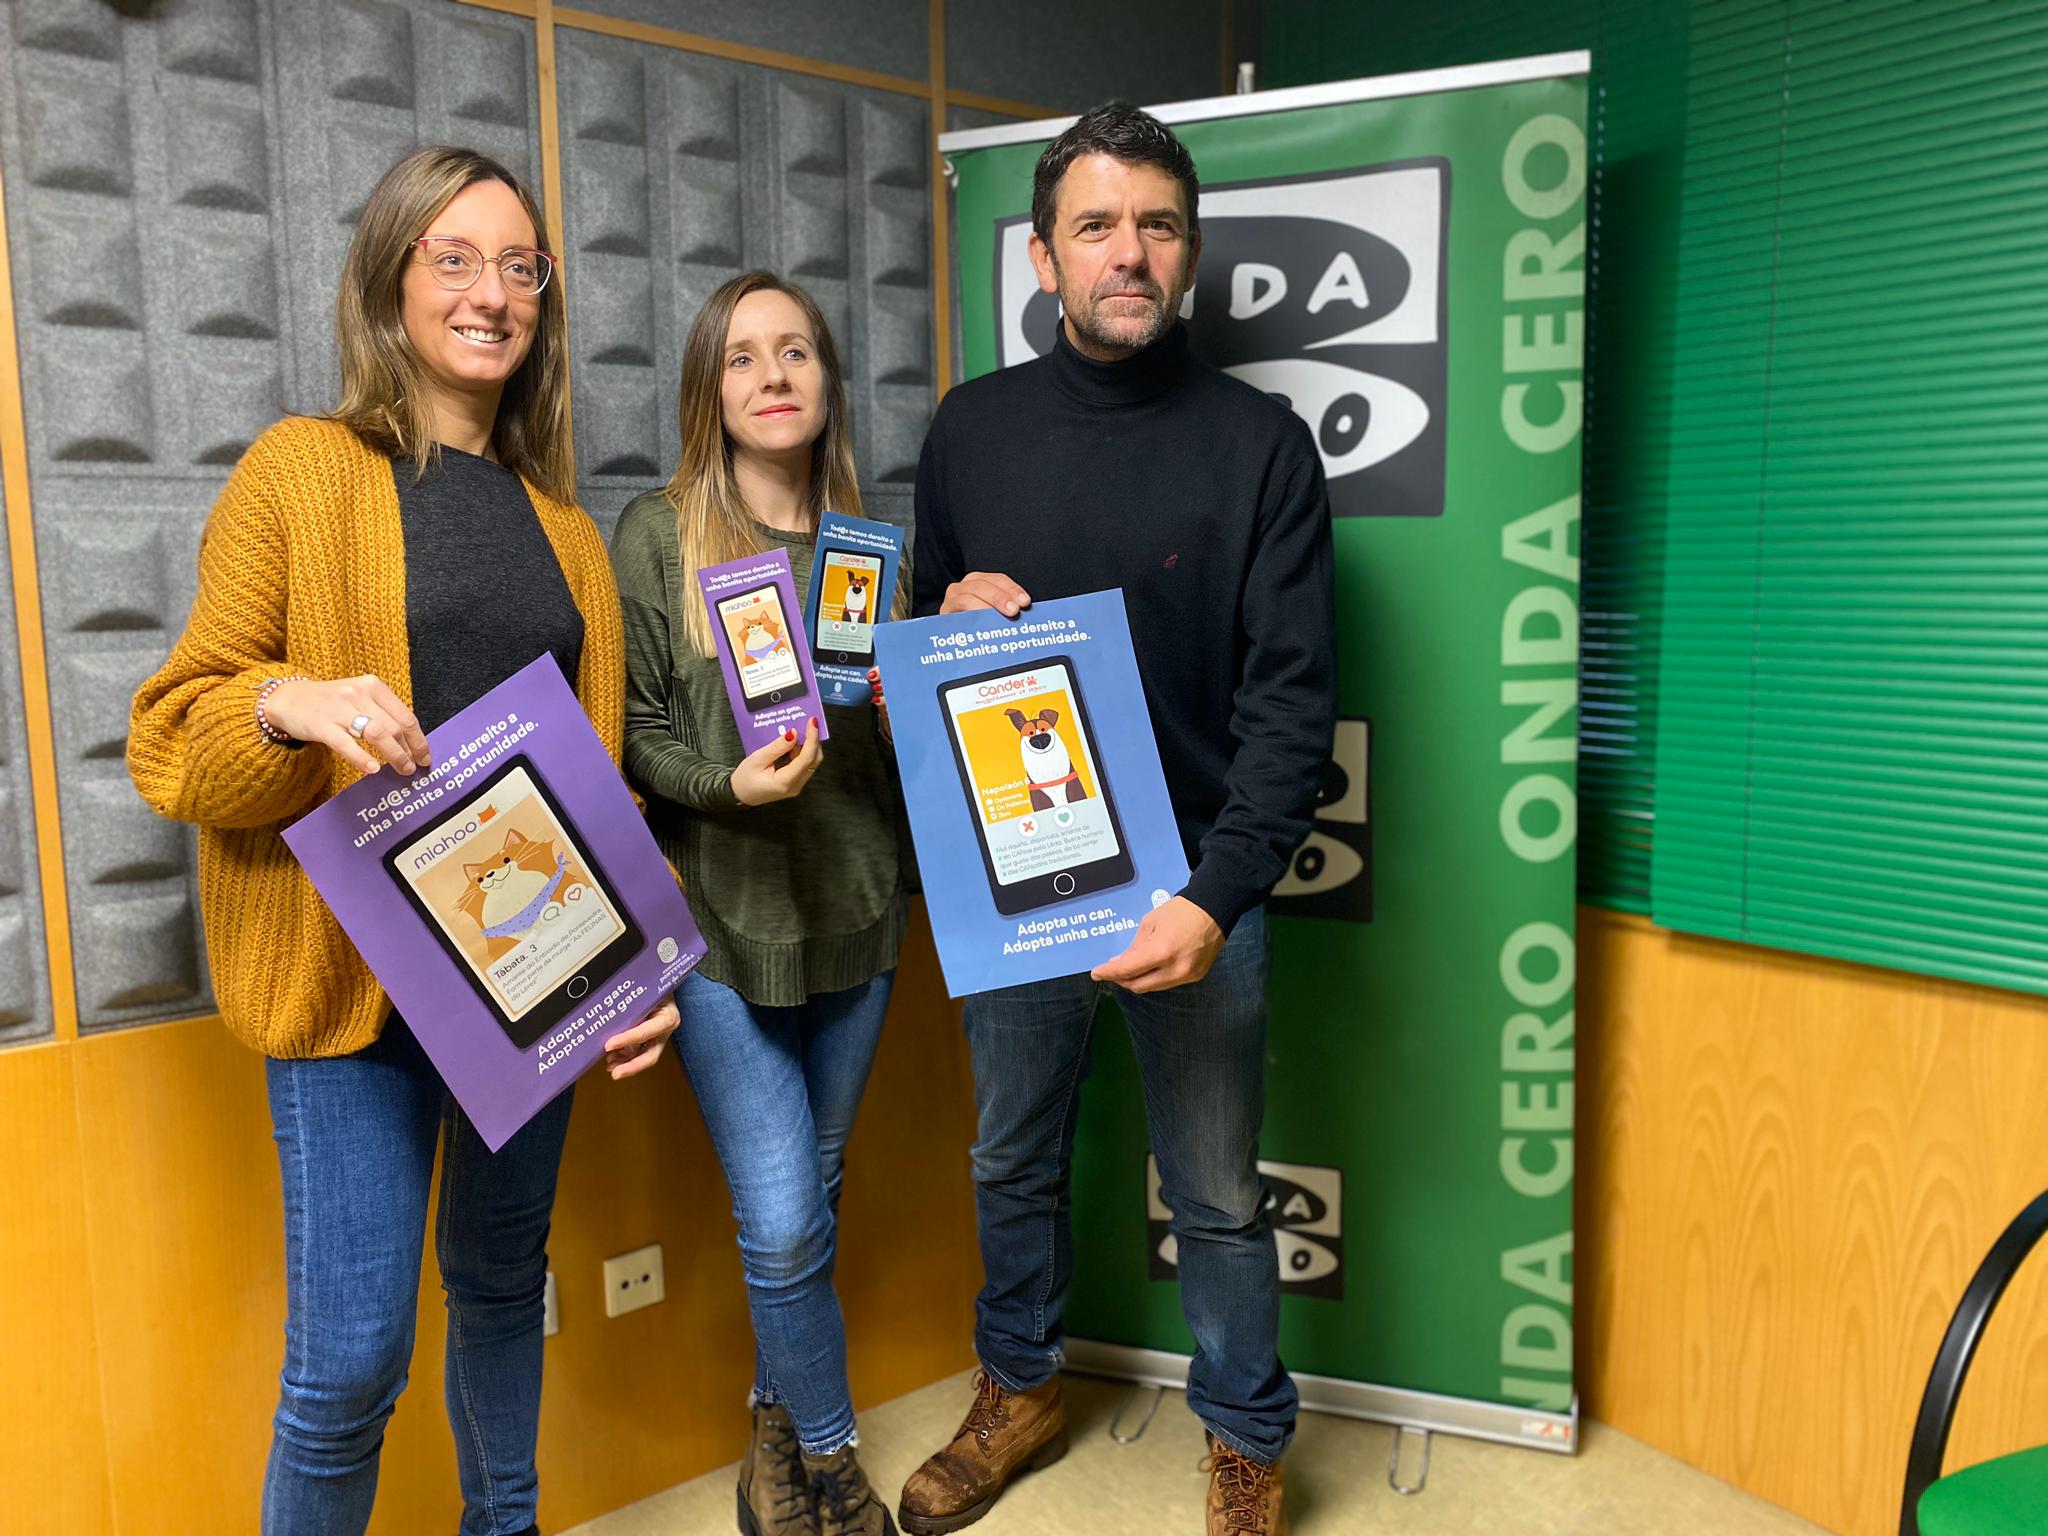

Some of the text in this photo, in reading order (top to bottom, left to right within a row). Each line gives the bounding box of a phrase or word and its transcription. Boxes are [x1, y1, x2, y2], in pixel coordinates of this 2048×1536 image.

[1501, 113, 1587, 454] CERO
[838, 534, 856, 543] bonita
[849, 529, 867, 538] temos
[868, 532, 889, 542] dereito
[722, 579, 743, 588] bonita
[731, 569, 752, 578] temos
[752, 562, 775, 573] dereito
[920, 630, 1092, 665] unha bonita oportunidade.
[929, 619, 1076, 648] Tod@s temos dereito a
[815, 671, 833, 680] dopta
[978, 677, 1025, 697] Cander
[1499, 493, 1582, 863] ONDA
[353, 719, 539, 848] unha bonita oportunidade.
[356, 712, 519, 824] Tod@s temos dereito a
[981, 779, 1024, 796] Napoleón
[414, 821, 477, 869] miahoo
[1003, 918, 1139, 955] Adopta unha cadela.
[1017, 907, 1117, 937] Adopta un can.
[529, 944, 538, 953] 3
[537, 979, 635, 1058] Adopta un gato.
[537, 985, 648, 1075] Adopta unha gata.
[1499, 921, 1576, 1197] CERO
